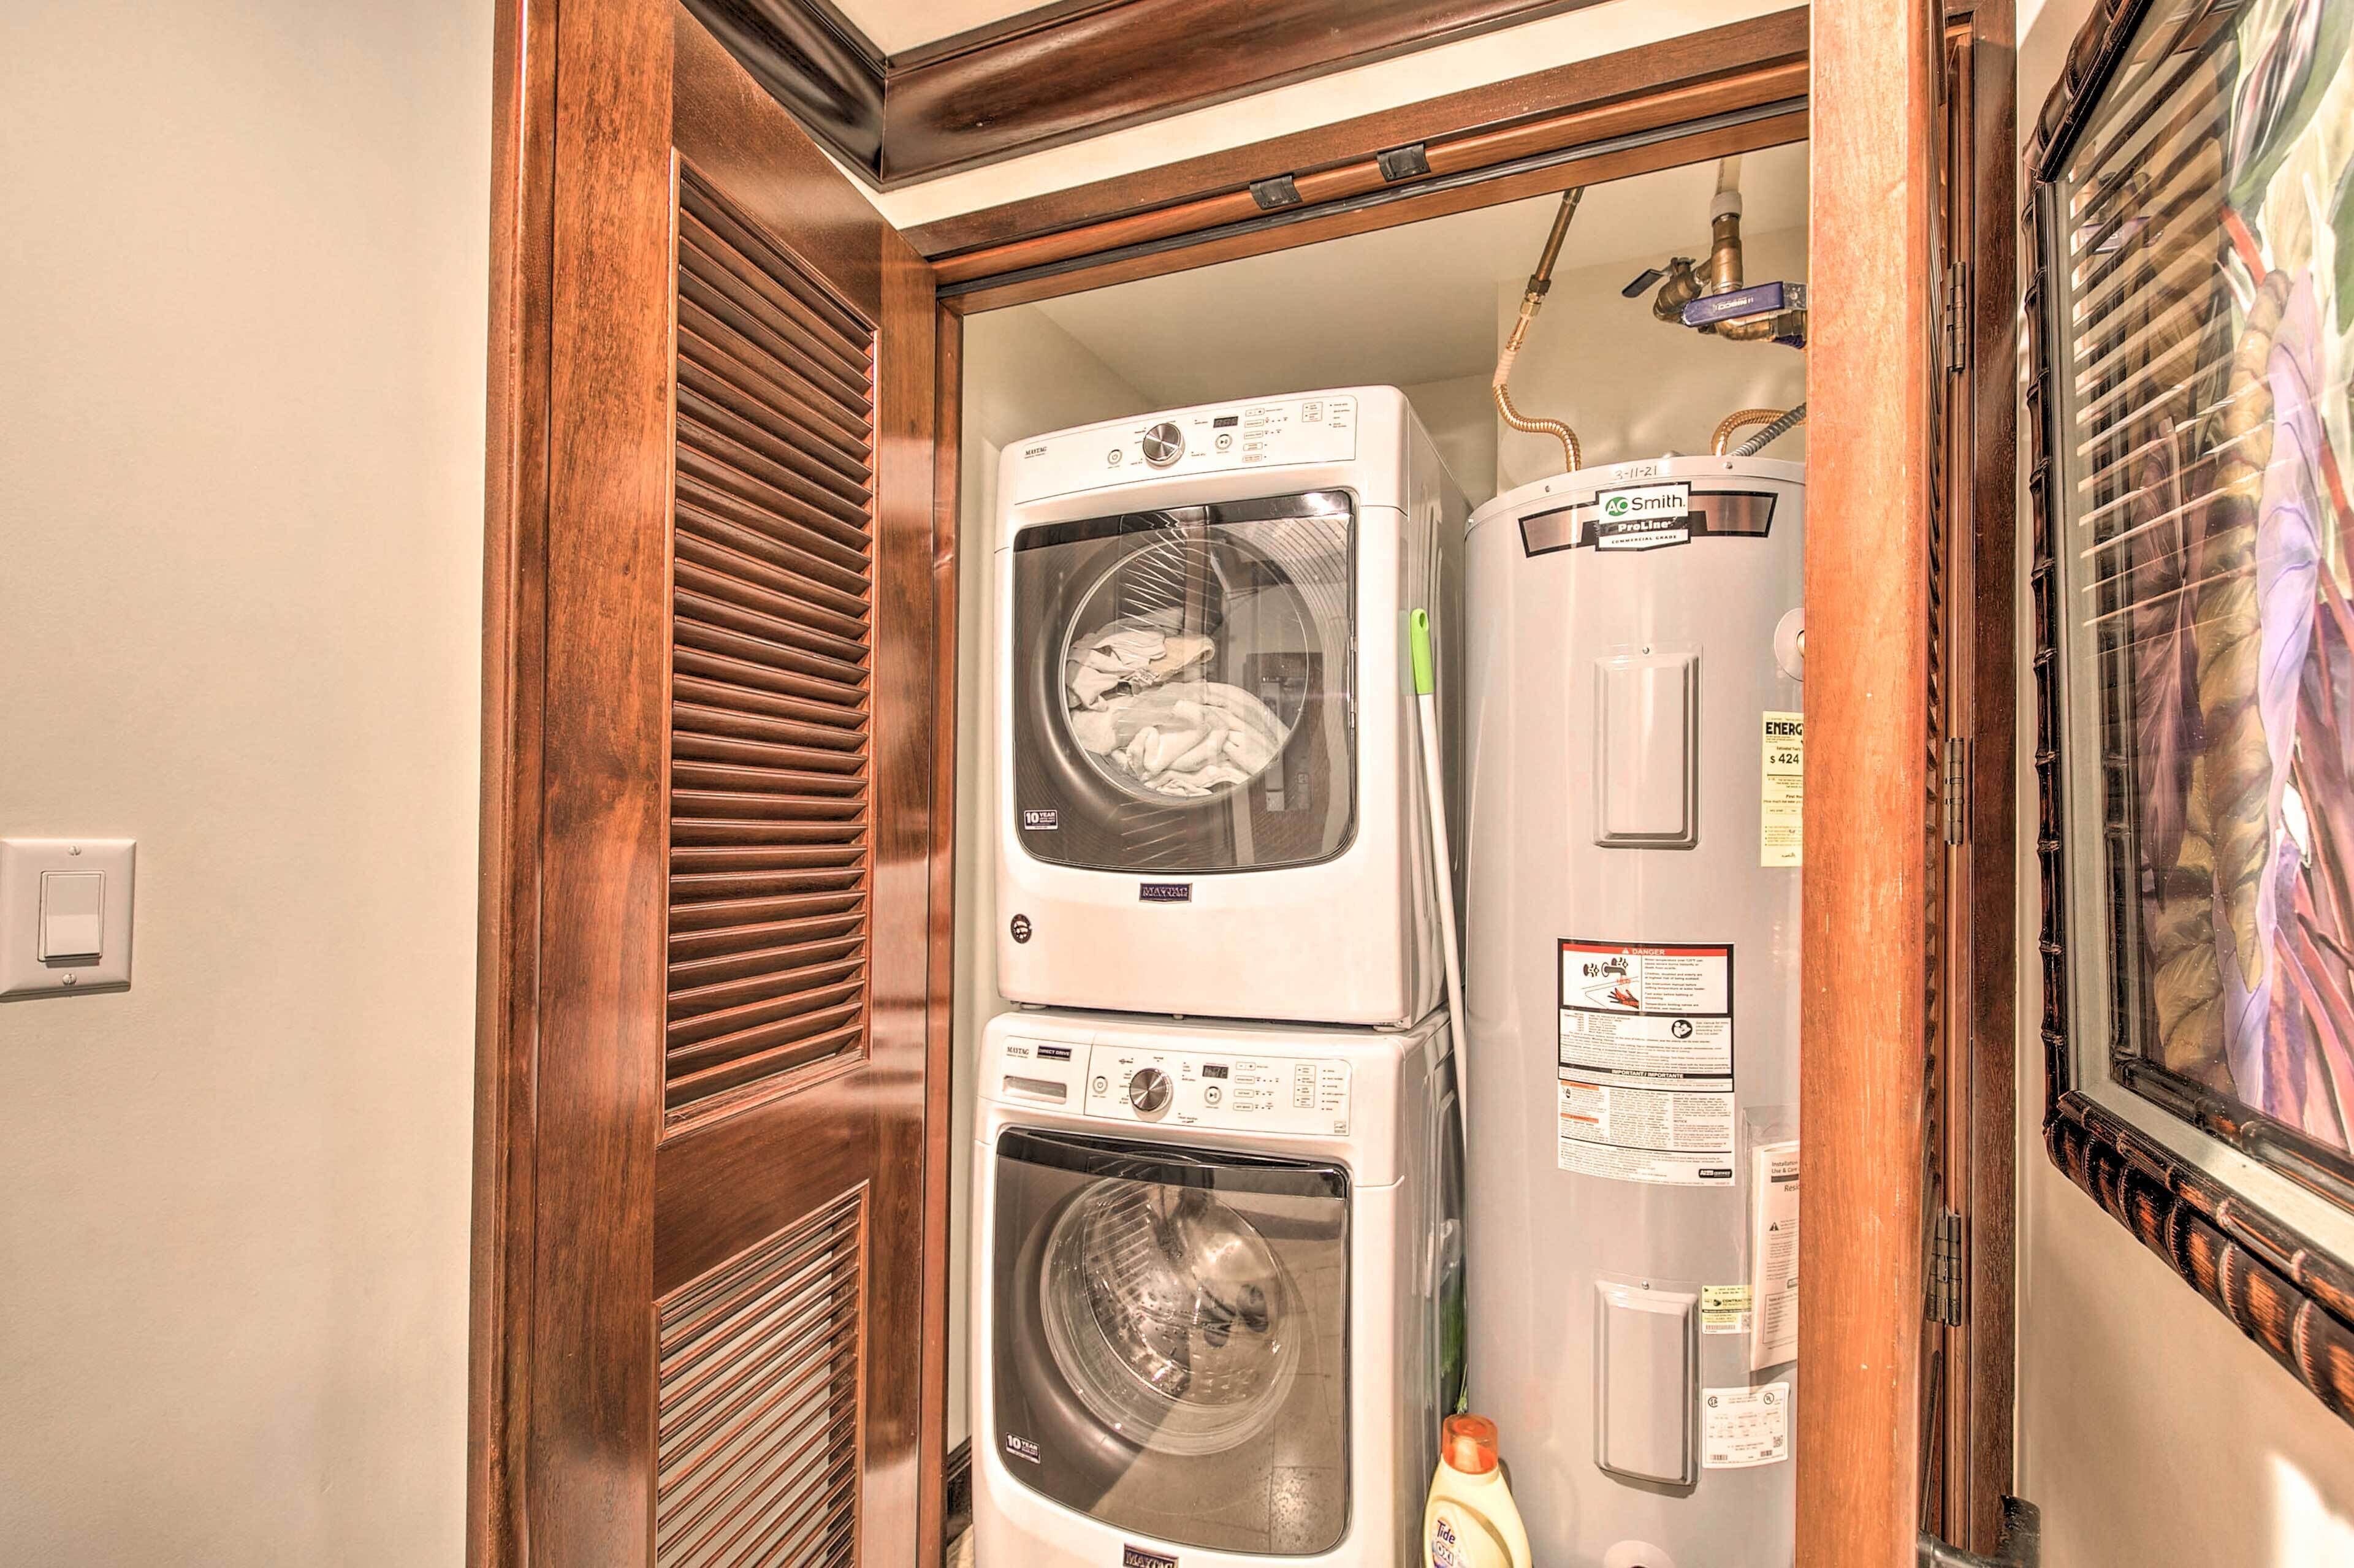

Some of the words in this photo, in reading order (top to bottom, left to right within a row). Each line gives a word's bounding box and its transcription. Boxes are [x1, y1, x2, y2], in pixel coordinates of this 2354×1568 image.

[1025, 446, 1047, 455] MAYTAG
[1618, 520, 1669, 532] ProLine
[1026, 812, 1039, 824] 10
[1143, 887, 1187, 897] MAYTAG
[1007, 1046, 1029, 1055] MAYTAG
[1007, 1434, 1021, 1450] 10
[1021, 1441, 1038, 1450] YEAR
[1438, 1520, 1455, 1544] Tide
